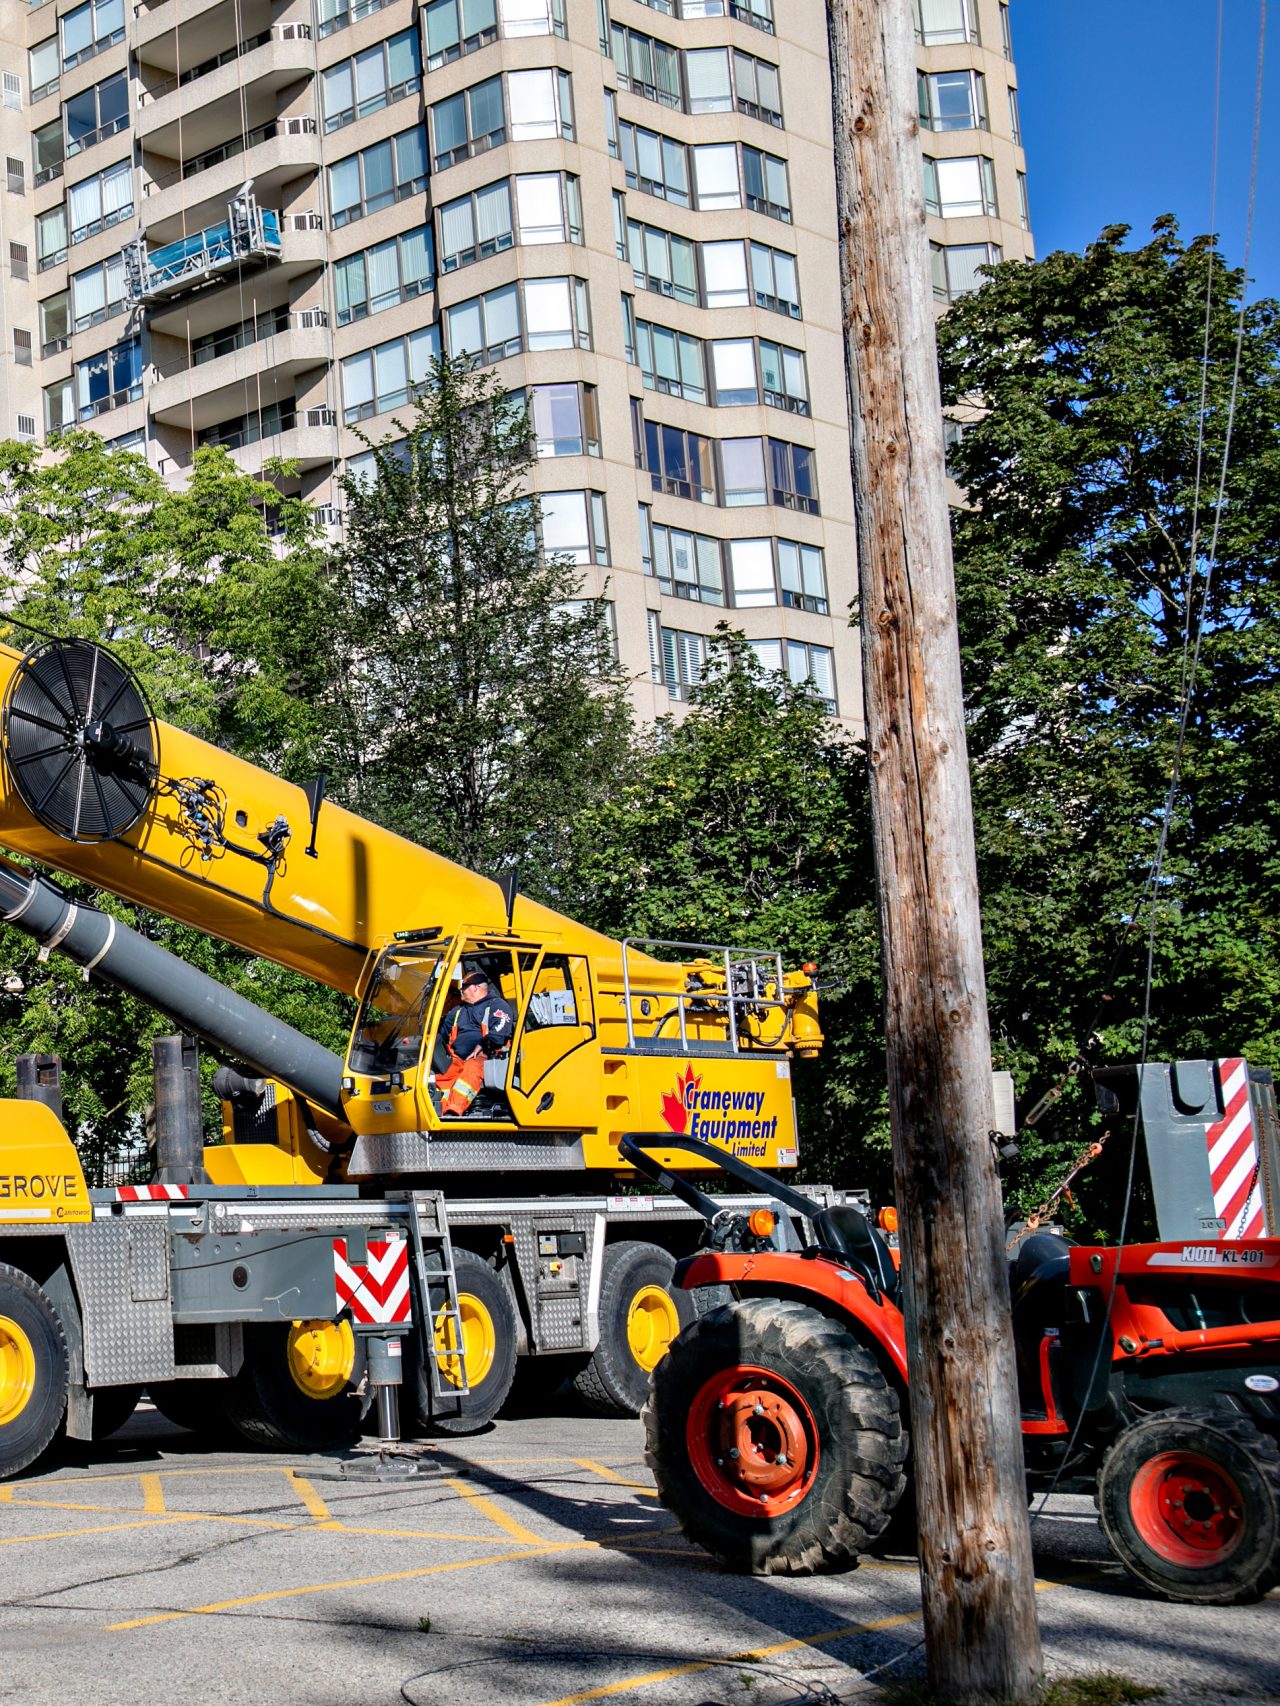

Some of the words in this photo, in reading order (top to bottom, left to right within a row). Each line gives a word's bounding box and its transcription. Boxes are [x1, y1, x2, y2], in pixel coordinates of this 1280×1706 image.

[685, 1082, 765, 1117] Craneway
[690, 1111, 777, 1145] Equipment
[732, 1141, 767, 1157] Limited
[1182, 1246, 1217, 1263] KIOTI
[1222, 1250, 1238, 1263] KL
[1241, 1249, 1265, 1263] 401
